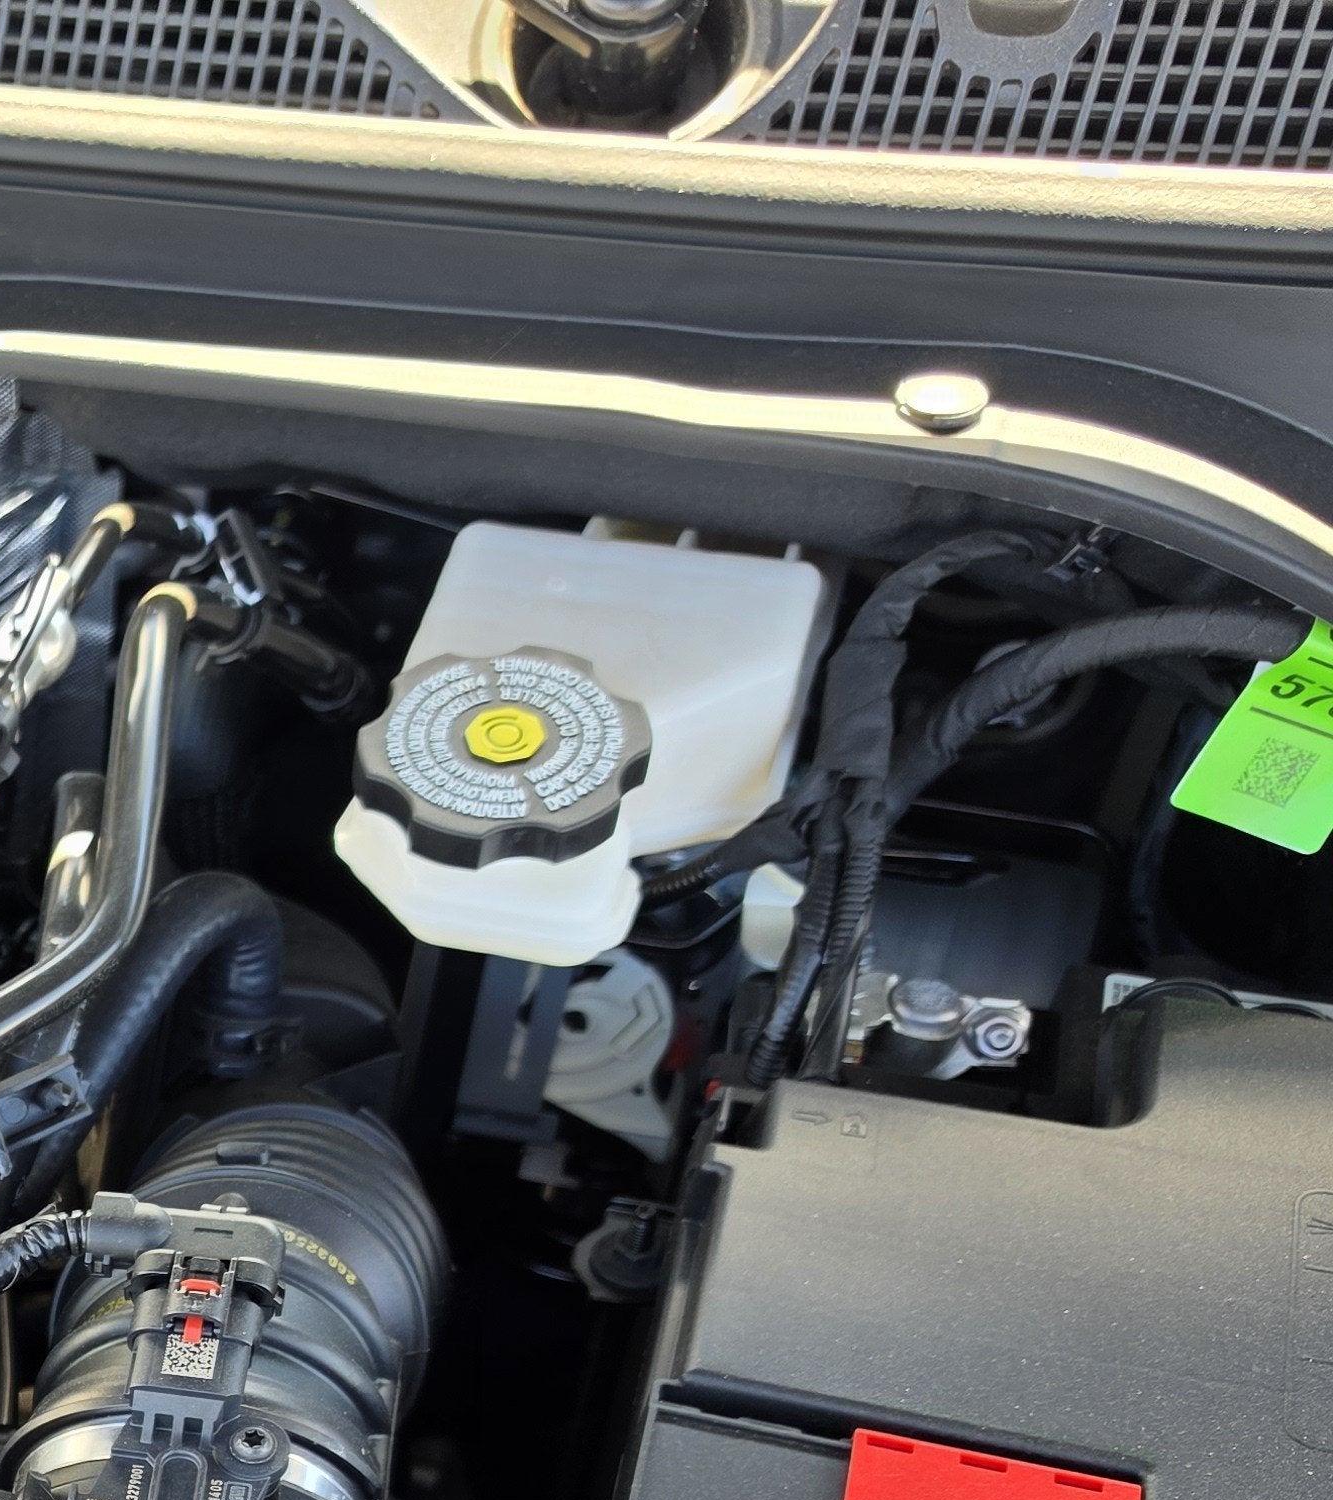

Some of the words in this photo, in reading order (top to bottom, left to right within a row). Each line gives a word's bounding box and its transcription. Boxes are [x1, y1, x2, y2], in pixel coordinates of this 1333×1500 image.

[494, 672, 538, 690] ONLY
[499, 687, 553, 710] FILLER
[1270, 673, 1333, 717] 57
